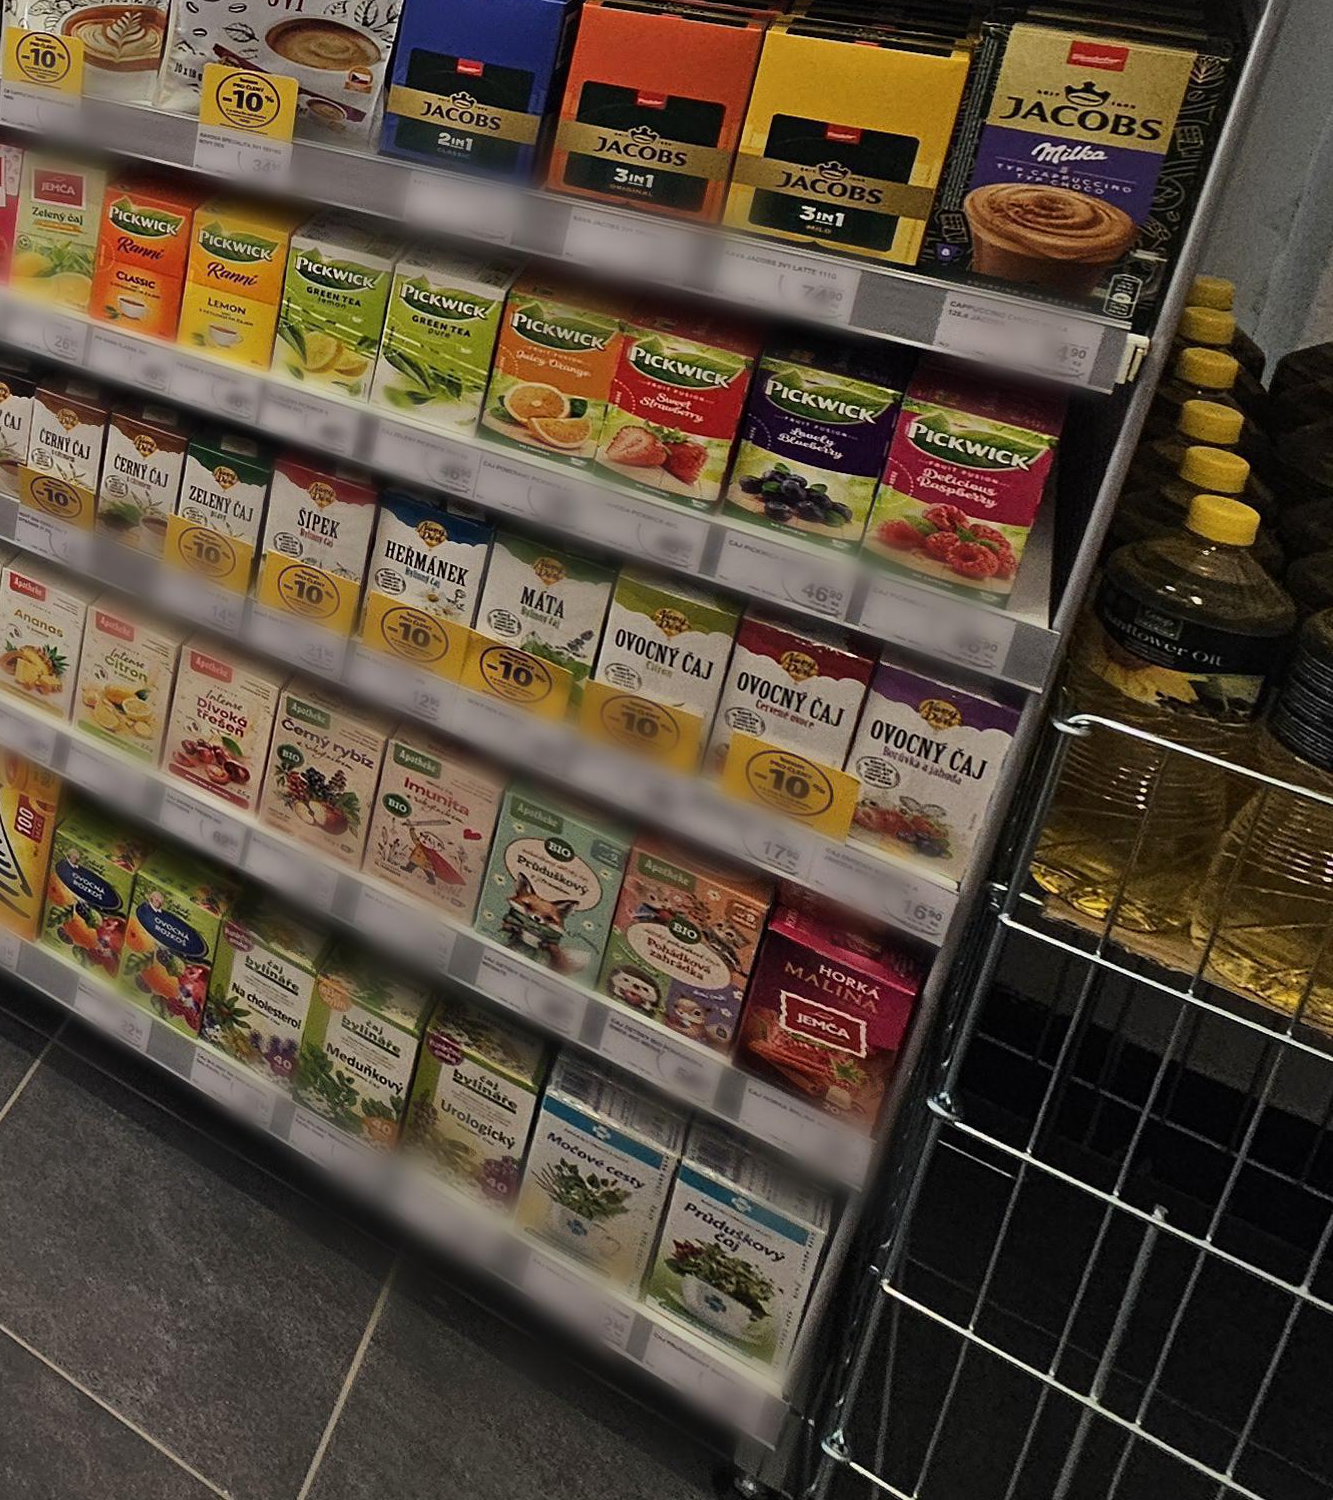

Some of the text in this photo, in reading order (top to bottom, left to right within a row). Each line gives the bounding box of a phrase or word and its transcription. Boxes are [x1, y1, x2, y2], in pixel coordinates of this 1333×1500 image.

[420, 100, 501, 132] JACOBS
[998, 97, 1163, 141] JACOBS
[593, 133, 687, 167] JACOBS
[1031, 142, 1108, 164] Milka
[780, 170, 883, 204] JACOBS
[109, 201, 180, 236] PICKWICK
[117, 238, 164, 262] Ranní
[207, 298, 246, 316] LEMON
[401, 282, 488, 321] PICKWICK
[412, 315, 472, 338] GREEN TEA
[512, 312, 605, 351] PICKWICK
[656, 392, 691, 409] Sweet
[764, 378, 876, 424] PICKWICK
[793, 427, 834, 445] Lovely
[917, 477, 997, 508] Raspberry
[924, 468, 996, 496] Delicious
[189, 486, 254, 522] ZELENÝ ČAJ
[298, 507, 339, 539] ŠÍPEK
[386, 539, 469, 587] HEŘMÁNEK
[520, 585, 564, 621] MÁTA
[14, 608, 64, 639] Ananas
[105, 655, 148, 682] Citron
[1192, 649, 1224, 668] Oil
[196, 697, 248, 728] Divoká
[736, 670, 844, 729] OVOCNÝ ČAJ
[870, 718, 988, 781] OVOCNÝ ČAJ
[403, 777, 470, 817] Imunita
[548, 841, 572, 858] BIO
[647, 937, 712, 973] Pohádková
[648, 951, 704, 982] zahrádka
[818, 962, 881, 998] HORKÁ
[232, 983, 302, 1030] Na cholesterol
[273, 1053, 292, 1071] 40
[326, 1042, 404, 1095] Meduňkový
[439, 1098, 516, 1150] Urologický
[546, 1131, 646, 1191] Močové cesty
[684, 1200, 786, 1263] Průduškový
[713, 1232, 740, 1256] čaj
